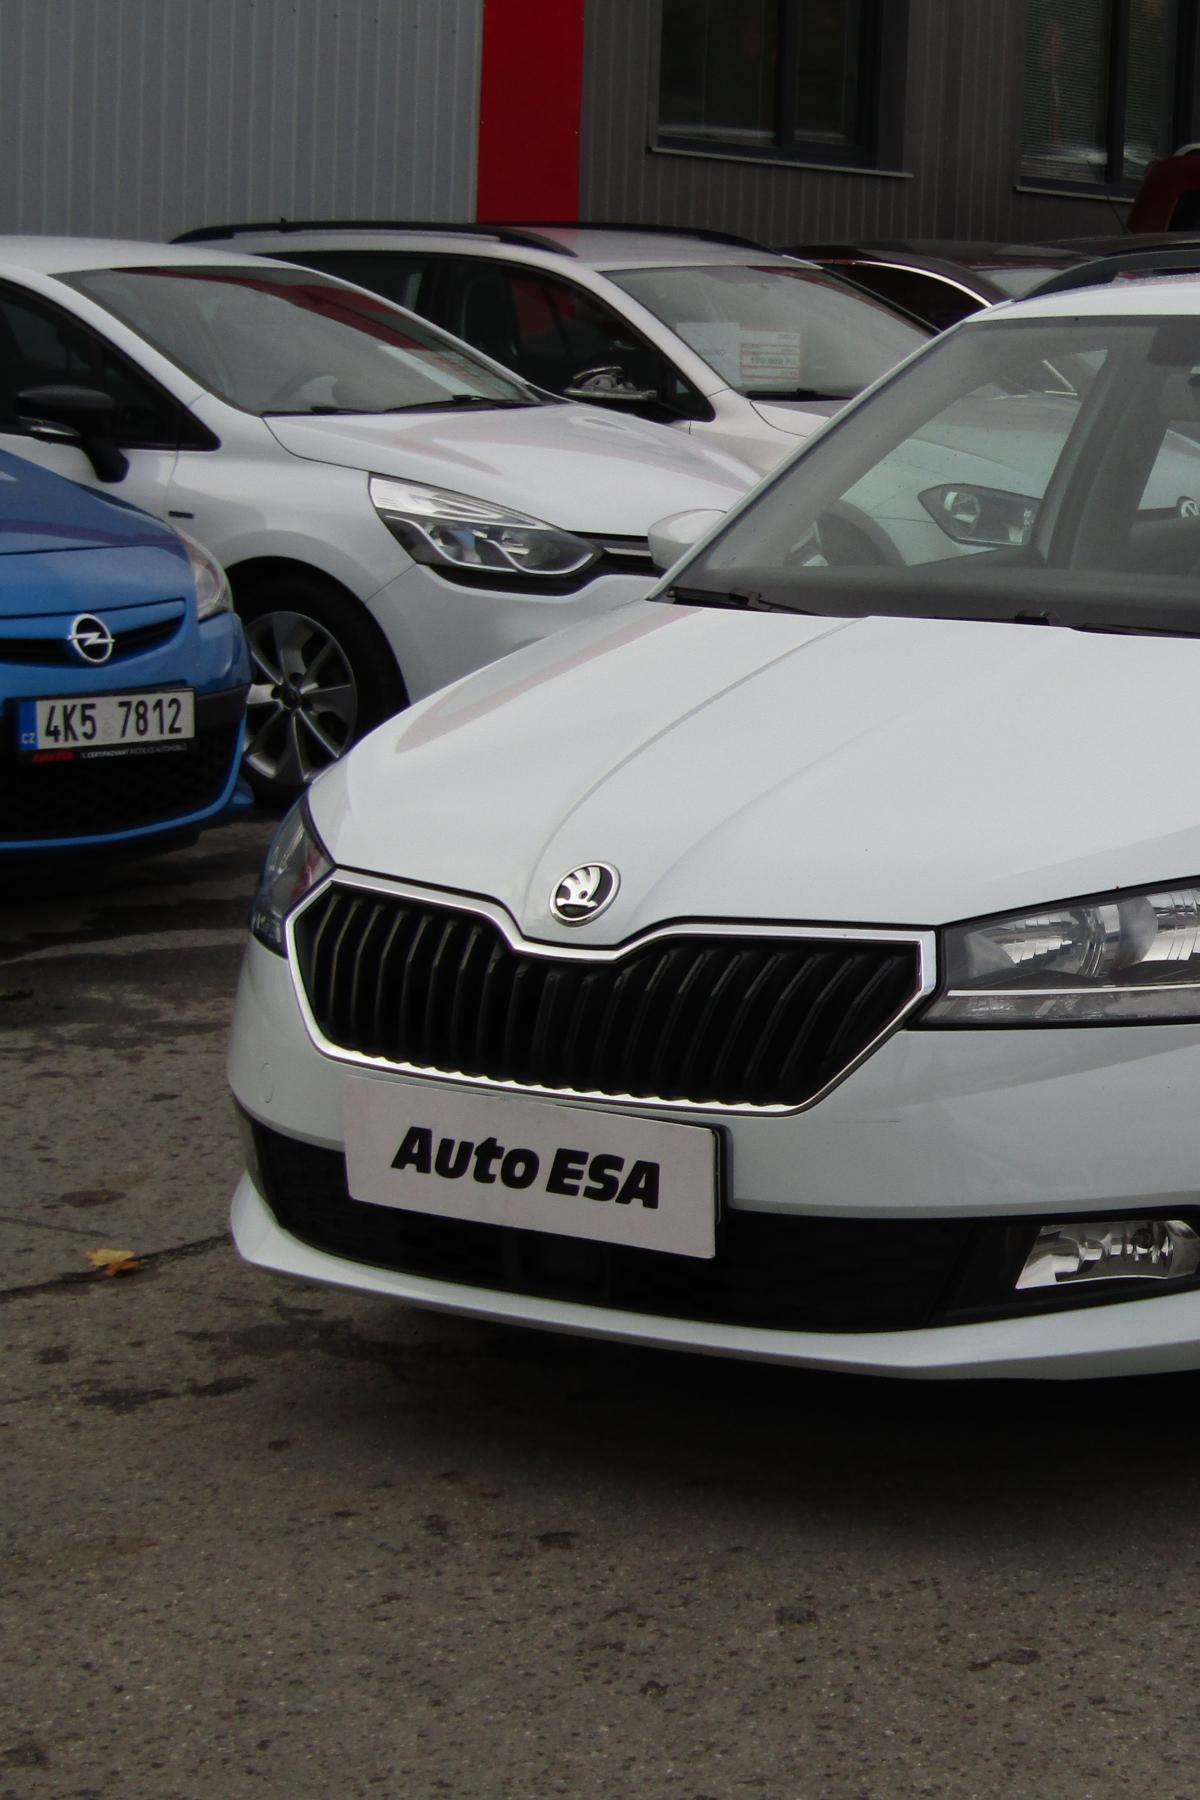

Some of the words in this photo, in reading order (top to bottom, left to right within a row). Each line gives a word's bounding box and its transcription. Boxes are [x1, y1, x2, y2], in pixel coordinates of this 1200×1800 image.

[21, 732, 36, 745] CZ
[45, 703, 97, 743] 4K5
[118, 698, 182, 738] 7812
[390, 1126, 540, 1190] Auto
[546, 1147, 660, 1210] ESA
